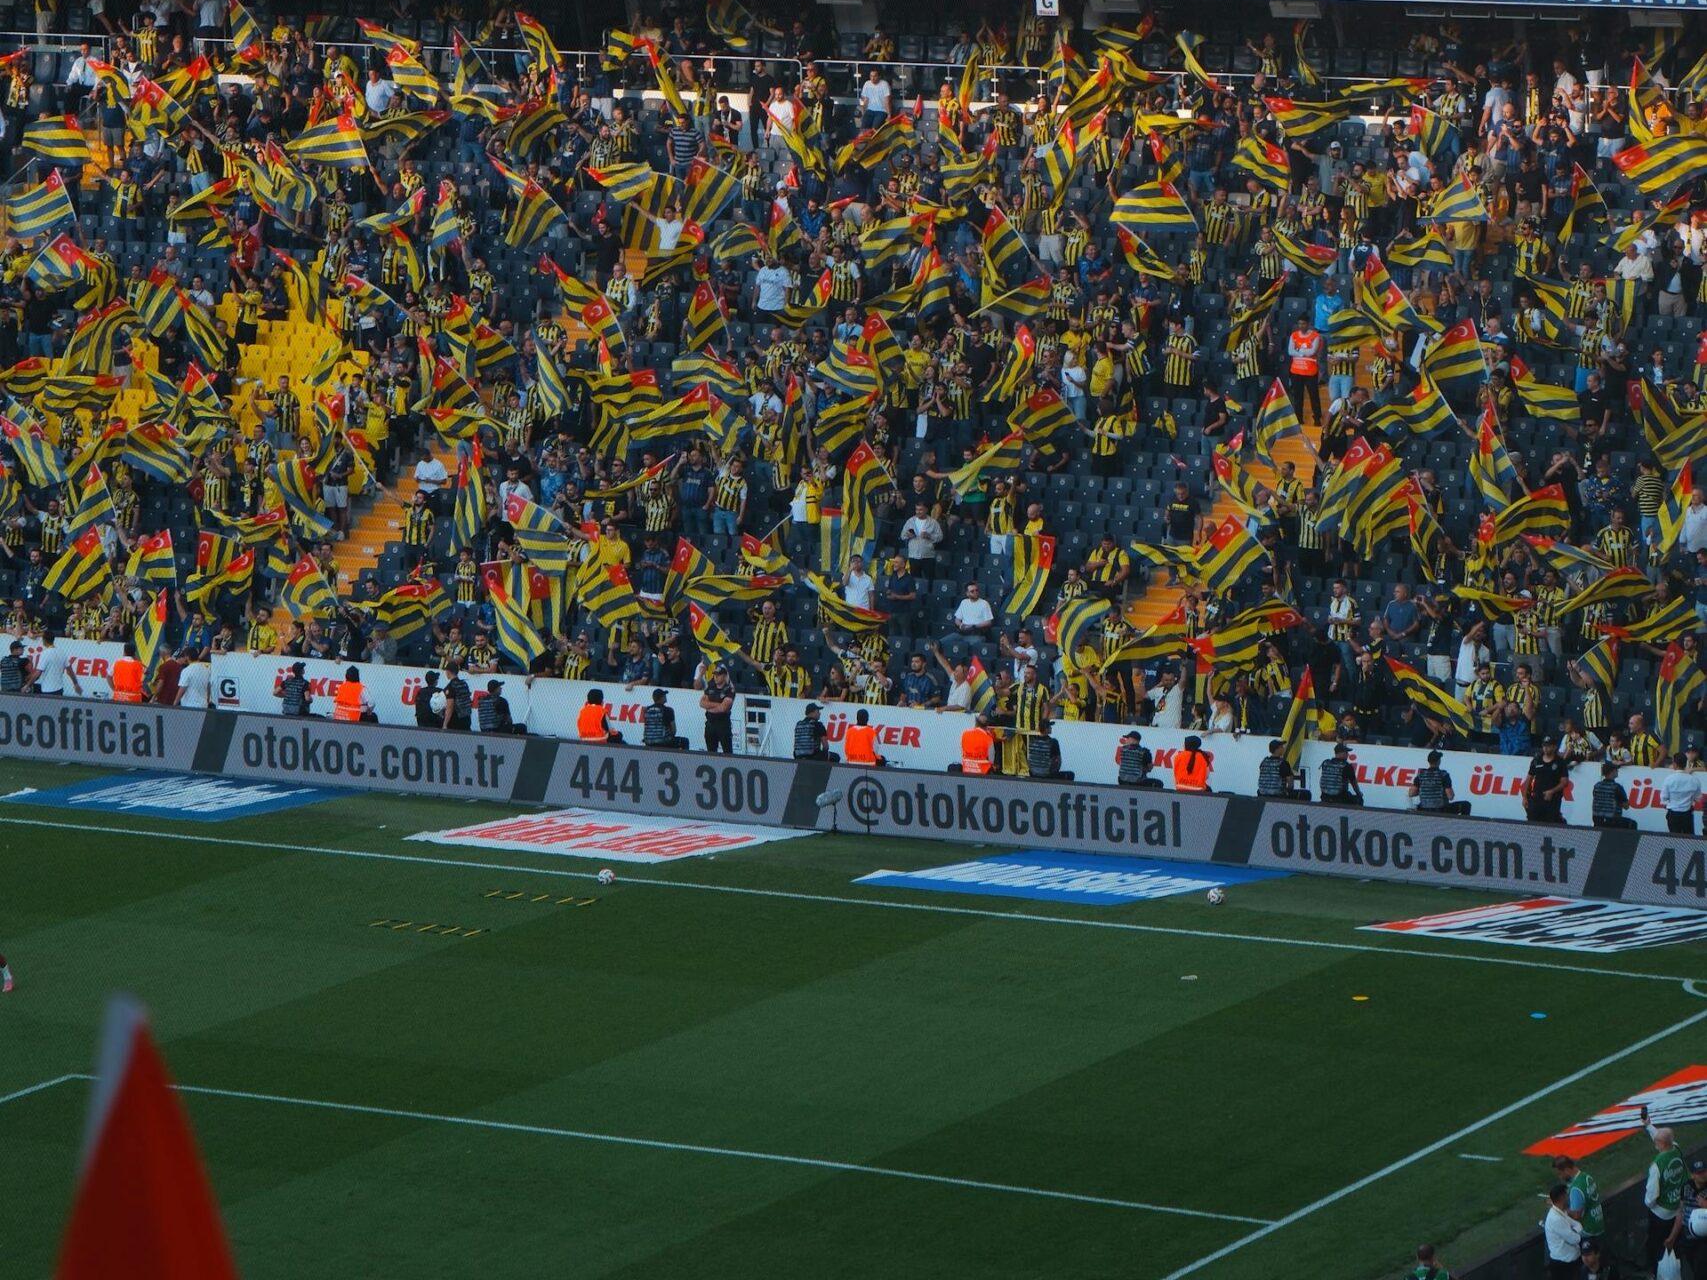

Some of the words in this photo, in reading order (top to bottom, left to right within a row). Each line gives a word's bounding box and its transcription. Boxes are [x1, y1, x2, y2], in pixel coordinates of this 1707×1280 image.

[27, 646, 109, 678] ÜER
[219, 678, 237, 698] G
[826, 712, 921, 748] ÜKER
[243, 726, 504, 788] otokoc.com.tr
[570, 755, 643, 803] 444
[657, 761, 681, 807] 3
[695, 765, 769, 814] 300
[1470, 764, 1575, 801] ÜLKR
[848, 776, 1181, 847] @otokocofficial
[1271, 814, 1575, 884] otokoc.com.tr
